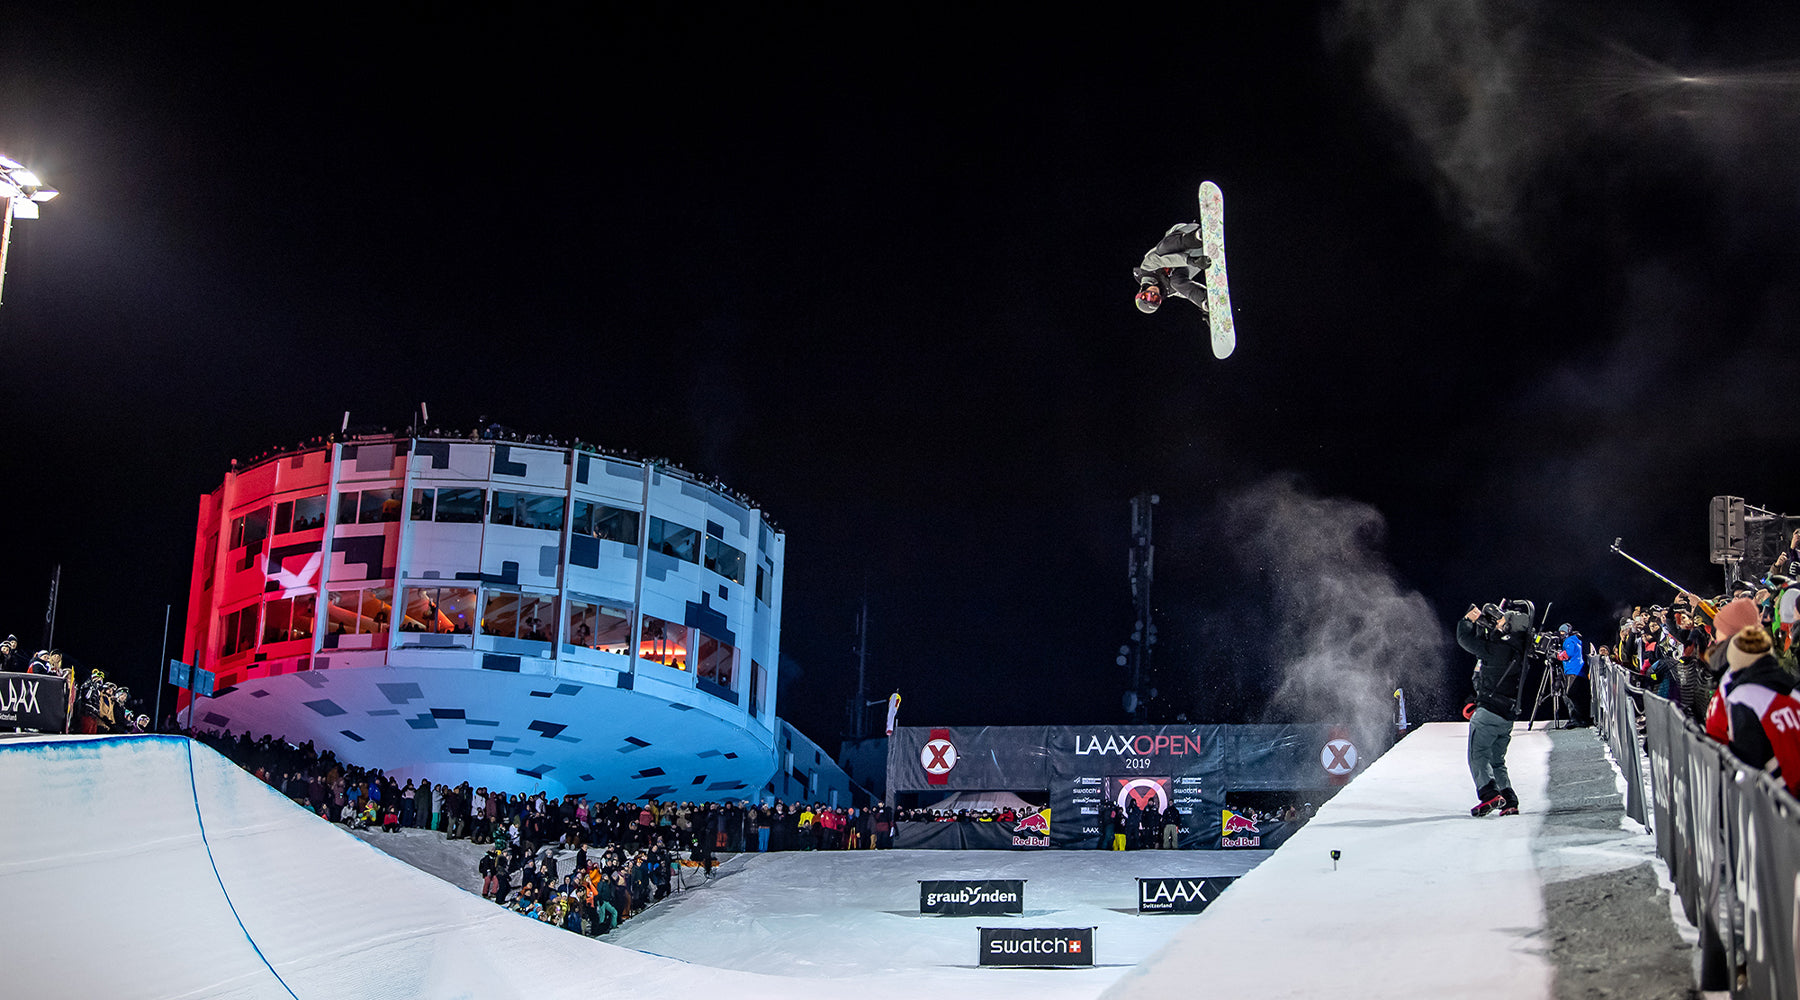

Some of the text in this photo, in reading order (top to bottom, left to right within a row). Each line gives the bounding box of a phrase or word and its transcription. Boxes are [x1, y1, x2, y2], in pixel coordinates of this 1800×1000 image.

[1125, 758, 1151, 769] 2019
[1082, 826, 1100, 834] LAAX
[1142, 880, 1208, 903] LAAX
[990, 937, 1067, 954] swatch
